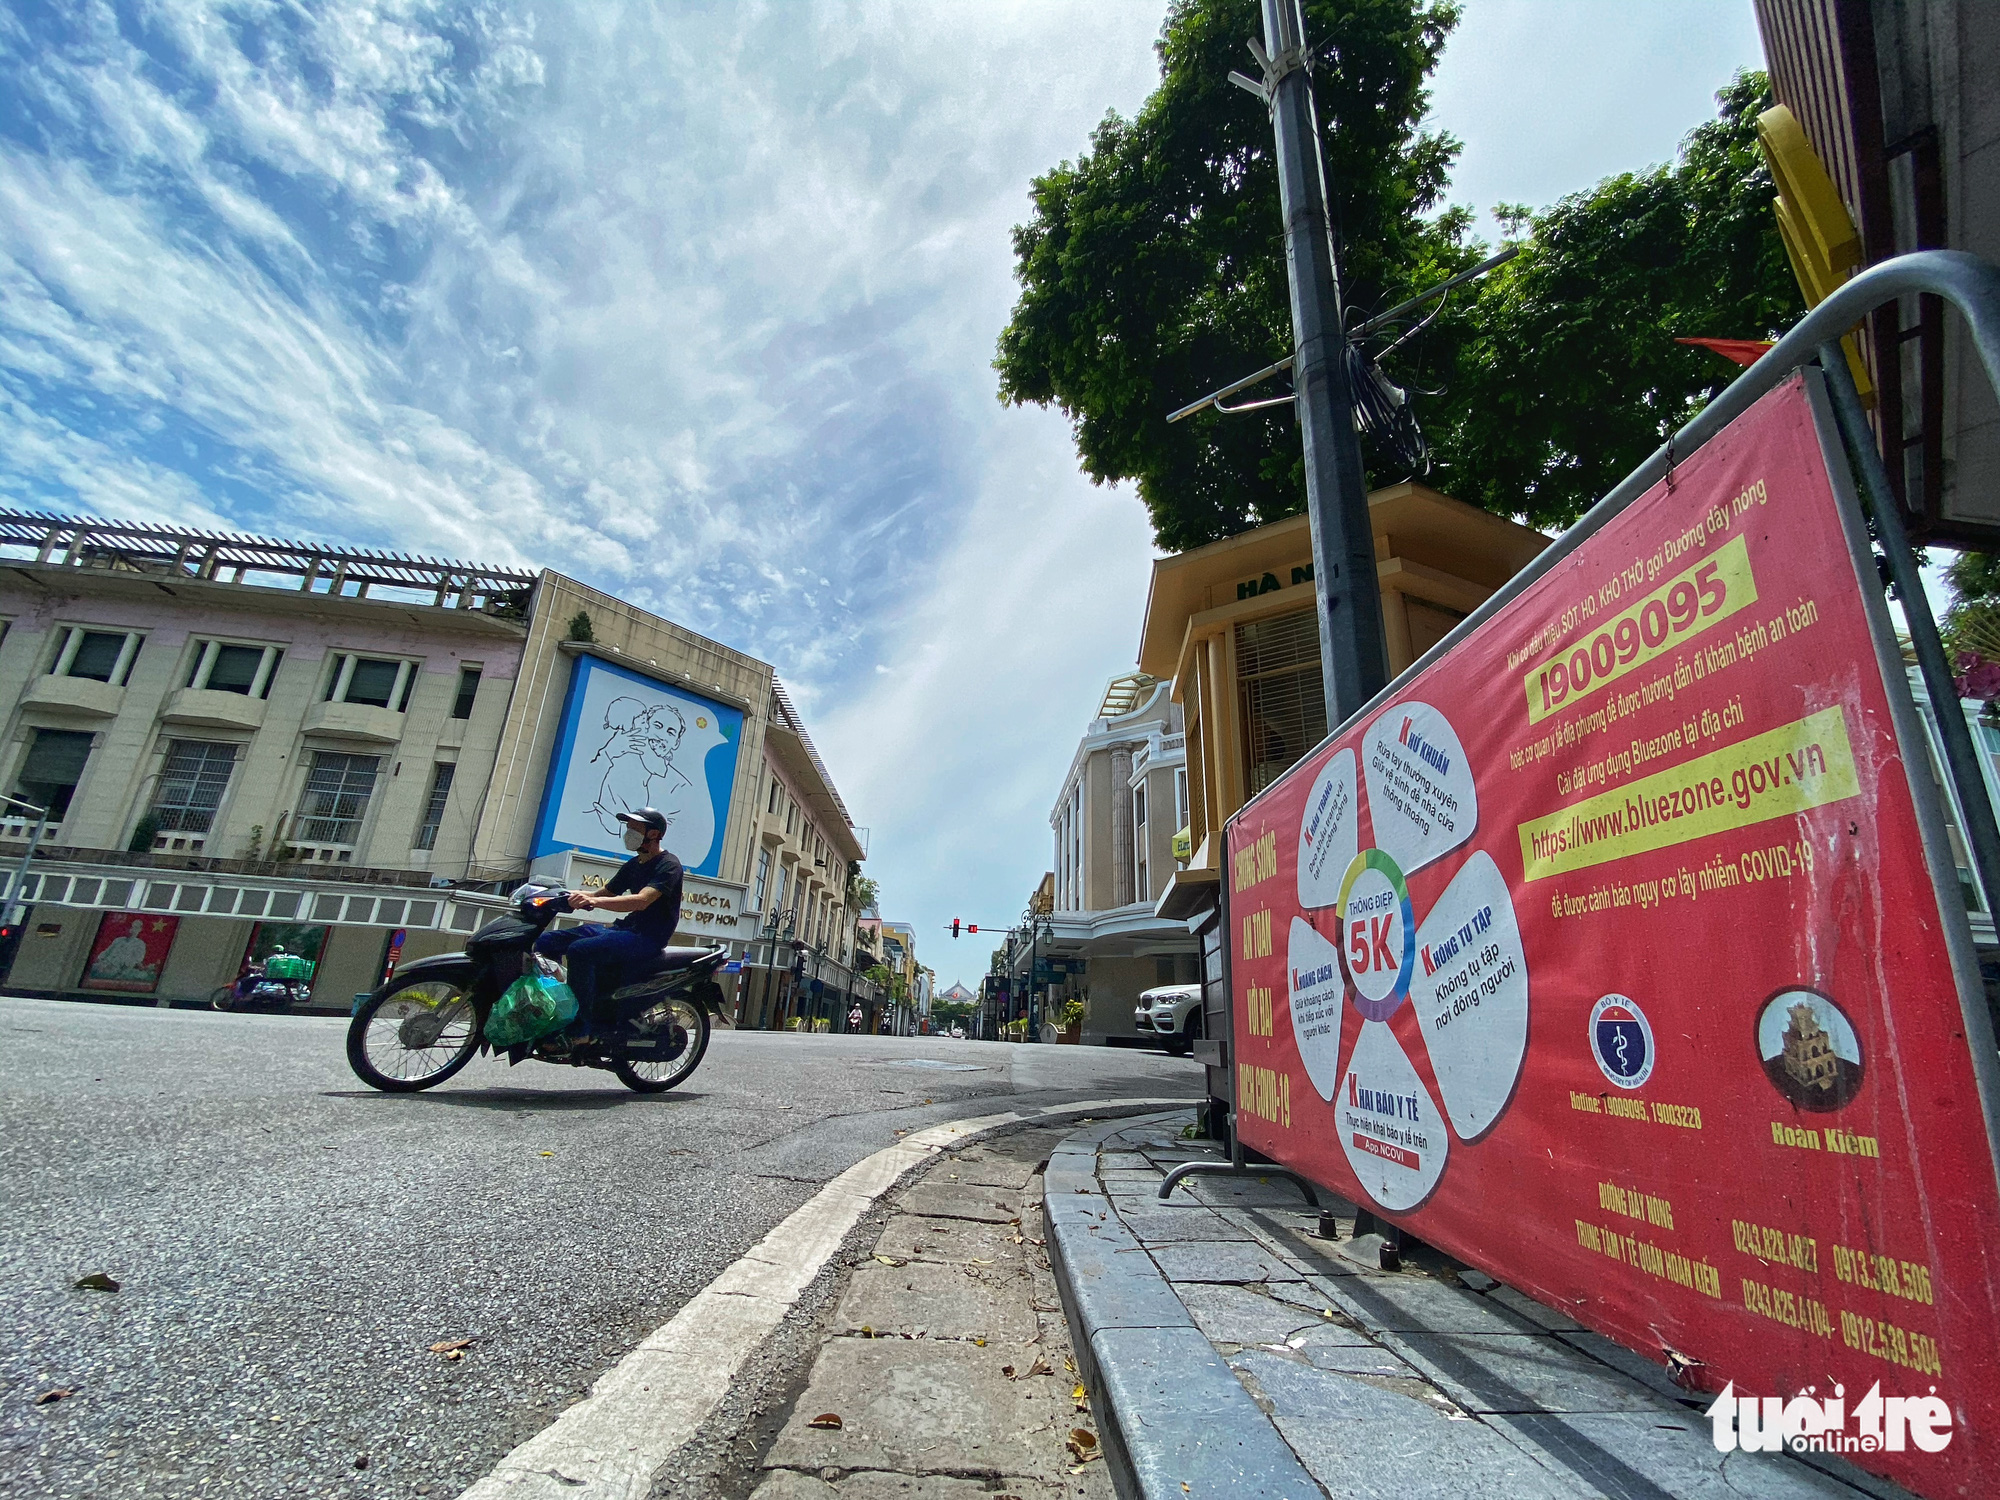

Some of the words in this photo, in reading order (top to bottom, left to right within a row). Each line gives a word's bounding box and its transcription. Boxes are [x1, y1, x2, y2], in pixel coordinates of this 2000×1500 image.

[1237, 572, 1281, 601] HÀ
[1507, 650, 1519, 671] Khi
[1520, 642, 1529, 662] có
[1530, 631, 1543, 656] dấu
[1543, 622, 1561, 647] hiệu
[1561, 604, 1581, 634] SỐT,
[1581, 597, 1598, 621] HO,
[1599, 572, 1620, 613] KHÓ
[1620, 556, 1645, 598] THỞ
[1647, 552, 1664, 581] gọi
[1665, 522, 1706, 565] Đường
[1706, 506, 1730, 540] dây
[1732, 478, 1767, 516] nóng
[1540, 560, 1727, 712] 19009095
[1509, 748, 1524, 771] hoặc
[1525, 745, 1534, 762] cơ
[1534, 739, 1551, 762] quan
[1550, 734, 1556, 757] y
[1563, 720, 1575, 748] địa
[1575, 708, 1607, 745] phương
[1607, 691, 1617, 723] để
[1618, 689, 1641, 719] được
[1641, 667, 1674, 704] hướng
[1674, 656, 1693, 691] dẫn
[1694, 650, 1705, 680] đi
[1705, 640, 1737, 674] khám
[1736, 621, 1769, 662] bệnh
[1769, 616, 1786, 643] an
[1788, 597, 1818, 634] toàn
[1398, 715, 1422, 753] KHỬ
[1420, 741, 1450, 776] KHUẨN
[1557, 766, 1572, 796] Cài
[1573, 760, 1586, 790] đặt
[1587, 756, 1606, 787] ứng
[1607, 746, 1631, 781] dụng
[1631, 727, 1682, 766] Bluezone
[1682, 712, 1699, 750] tại
[1700, 703, 1721, 742] địa
[1723, 694, 1744, 726] chỉ
[1318, 780, 1333, 814] TRANG
[1372, 756, 1385, 773] Giữ
[1385, 768, 1394, 783] vệ
[1394, 776, 1409, 795] sinh
[1410, 787, 1421, 803] để
[1438, 812, 1455, 832] cửa
[1376, 741, 1390, 759] Rửa
[1391, 751, 1403, 770] tay
[1432, 785, 1458, 812] xuyên
[1530, 742, 1827, 862] https://www.bluezone.gov.vn
[1319, 848, 1328, 868] nơi
[1325, 822, 1338, 849] công
[1336, 793, 1348, 821] cộng
[1326, 800, 1338, 827] trang
[1383, 784, 1403, 812] thông
[1403, 801, 1430, 836] thoáng
[1256, 819, 1277, 883] SỐNG
[1552, 884, 1563, 918] để
[1564, 887, 1588, 919] được
[1589, 878, 1610, 910] cảnh
[1611, 878, 1631, 907] báo
[1632, 881, 1659, 910] nguy
[1662, 878, 1677, 898] cơ
[1678, 867, 1697, 900] lây
[1698, 853, 1740, 891] nhiễm
[1741, 840, 1814, 883] COVID-19
[695, 910, 714, 924] ĐẸP
[720, 898, 731, 909] TA
[1243, 915, 1252, 960] AN
[1252, 900, 1273, 959] TOÀN
[1349, 897, 1374, 915] THÔNG
[1375, 891, 1394, 910] ĐIỆP
[1351, 913, 1398, 974] 5K
[1421, 935, 1460, 977] KHÔNG
[1457, 923, 1473, 946] TỤ
[1471, 905, 1492, 935] TẬP
[1294, 998, 1304, 1010] Giữ
[1304, 992, 1322, 1009] khoảng
[1322, 988, 1335, 1003] cách
[1317, 963, 1332, 985] CÁCH
[1434, 970, 1468, 1003] Không
[1468, 959, 1481, 976] tụ
[1480, 943, 1499, 967] tập
[1435, 1006, 1452, 1030] nơi
[1453, 988, 1480, 1017] đông
[1480, 956, 1516, 996] người
[1247, 978, 1259, 1036] VỚI
[1302, 1027, 1317, 1040] người
[1317, 1023, 1330, 1034] khác
[1305, 1010, 1315, 1023] tiếp
[1315, 1007, 1325, 1018] xúc
[1325, 1004, 1334, 1017] với
[1239, 1063, 1255, 1122] DỊCH
[1255, 1066, 1290, 1128] COVID-19
[1348, 1073, 1373, 1111] KHAI
[1376, 1090, 1394, 1116] BÁO
[1397, 1096, 1404, 1119] Y
[1405, 1090, 1419, 1122] TẾ
[1569, 1090, 1602, 1114] Hotline:
[1602, 1094, 1650, 1123] 19009095,
[1650, 1102, 1702, 1129] 19003228
[1346, 1112, 1360, 1131] Thực
[1360, 1116, 1372, 1135] hiện
[1373, 1120, 1386, 1137] khai
[1386, 1124, 1398, 1140] báo
[1399, 1132, 1405, 1146] y
[1405, 1127, 1412, 1144] tế
[1413, 1131, 1428, 1150] trên
[1365, 1139, 1379, 1155] App
[1380, 1145, 1404, 1162] NCOVI
[1771, 1121, 1820, 1149] Hoàn
[1824, 1127, 1879, 1158] Kiếm
[1598, 1179, 1627, 1216] ĐƯỜNG
[1628, 1186, 1645, 1221] DÂY
[1647, 1191, 1674, 1230] NÓNG
[1575, 1219, 1602, 1252] TRUNG
[1601, 1225, 1619, 1259] TÂM
[1619, 1237, 1627, 1263] Y
[1626, 1230, 1639, 1268] TẾ
[1638, 1241, 1664, 1282] QUẬN
[1665, 1250, 1692, 1288] HOÀN
[1694, 1257, 1722, 1299] KIẾM
[1832, 1244, 1934, 1306] 0913.388.506
[1840, 1310, 1942, 1379] 0912.539.504
